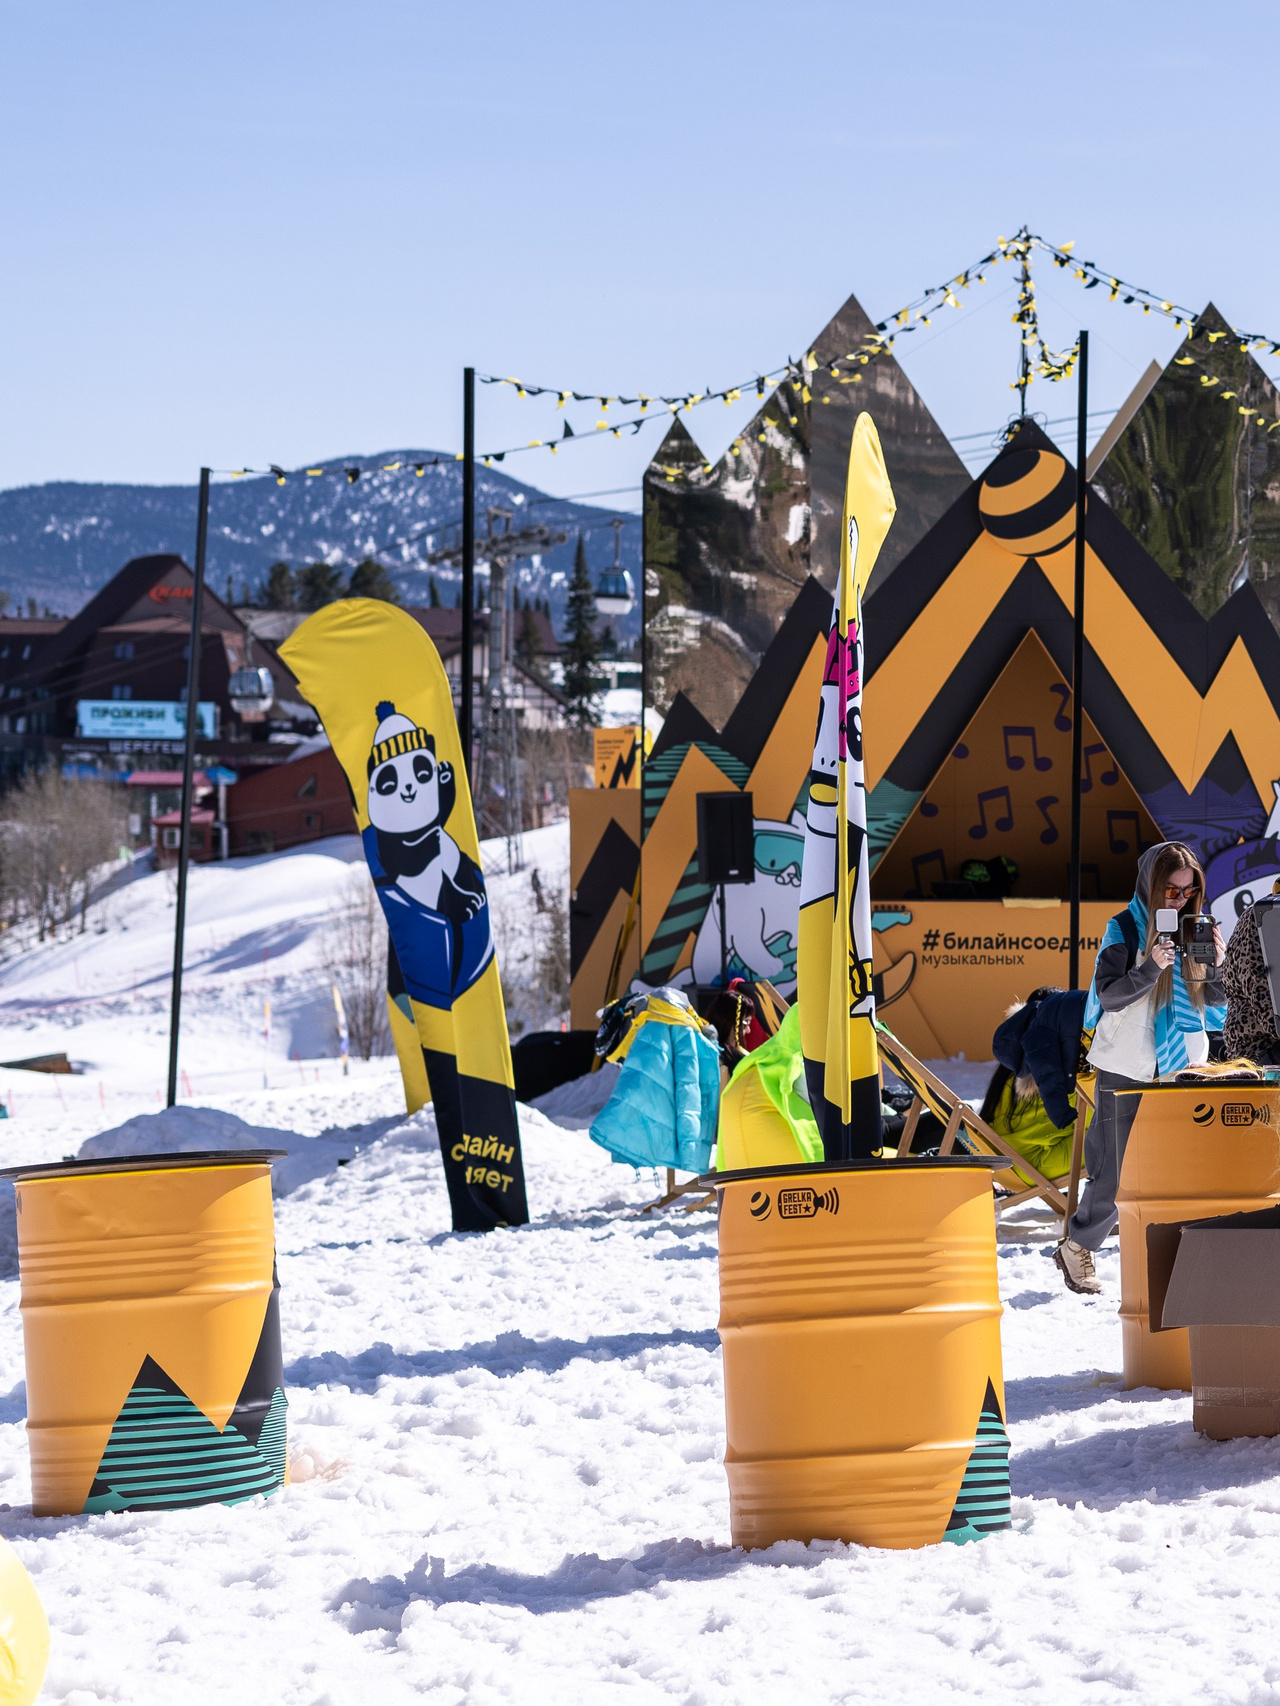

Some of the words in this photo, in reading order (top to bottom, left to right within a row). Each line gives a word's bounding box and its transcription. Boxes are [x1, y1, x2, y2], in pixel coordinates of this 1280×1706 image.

[91, 707, 166, 719] ПРОЖИВИ
[109, 741, 187, 754] ШЕРЕГЕШ
[922, 929, 1102, 953] #билайнсоедин
[921, 954, 1025, 969] музыкальных
[1226, 1106, 1250, 1115] GRELKA
[1226, 1115, 1243, 1123] FEST
[782, 1192, 812, 1204] GRELKA
[783, 1203, 803, 1215] FEST
